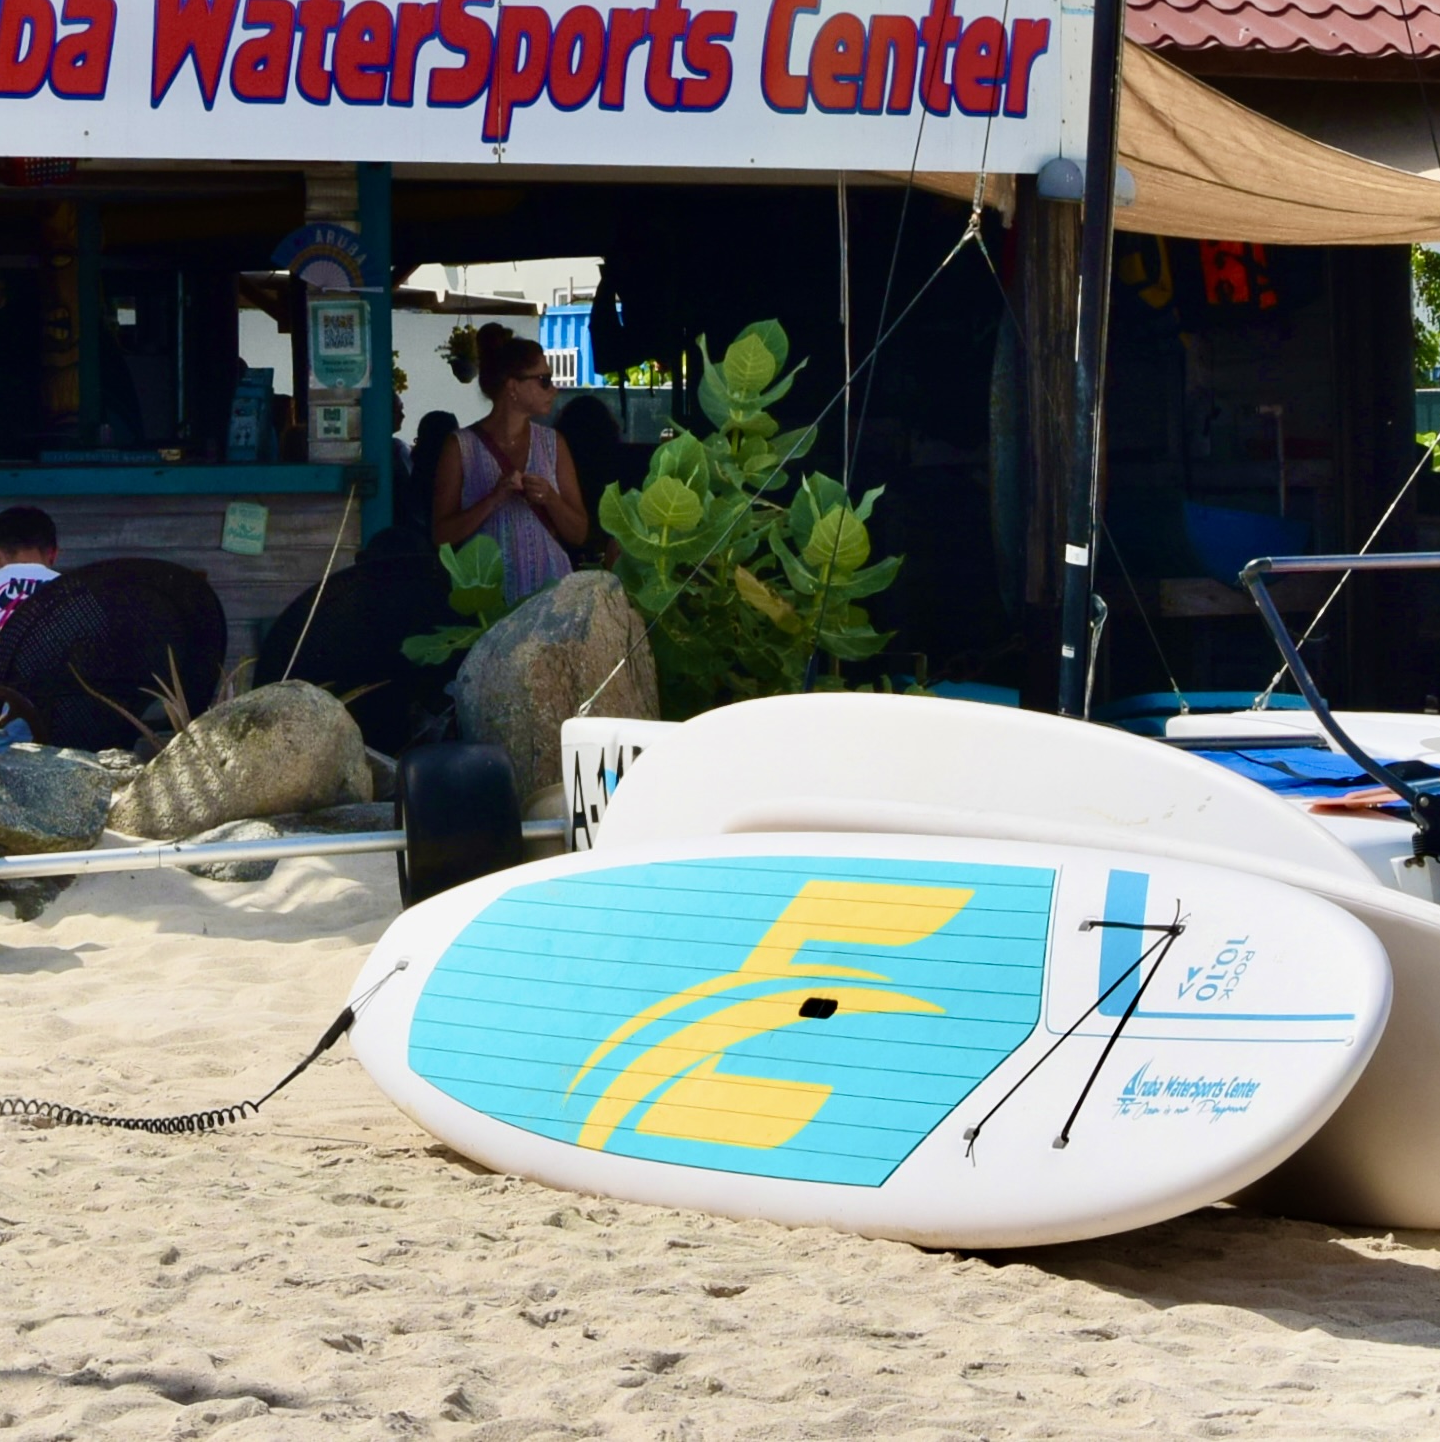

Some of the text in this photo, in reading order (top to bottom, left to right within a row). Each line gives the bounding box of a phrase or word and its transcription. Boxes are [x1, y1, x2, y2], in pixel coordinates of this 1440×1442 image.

[316, 229, 367, 266] ARUBA
[1218, 950, 1255, 1001] ROCK
[1224, 1076, 1261, 1099] Center
